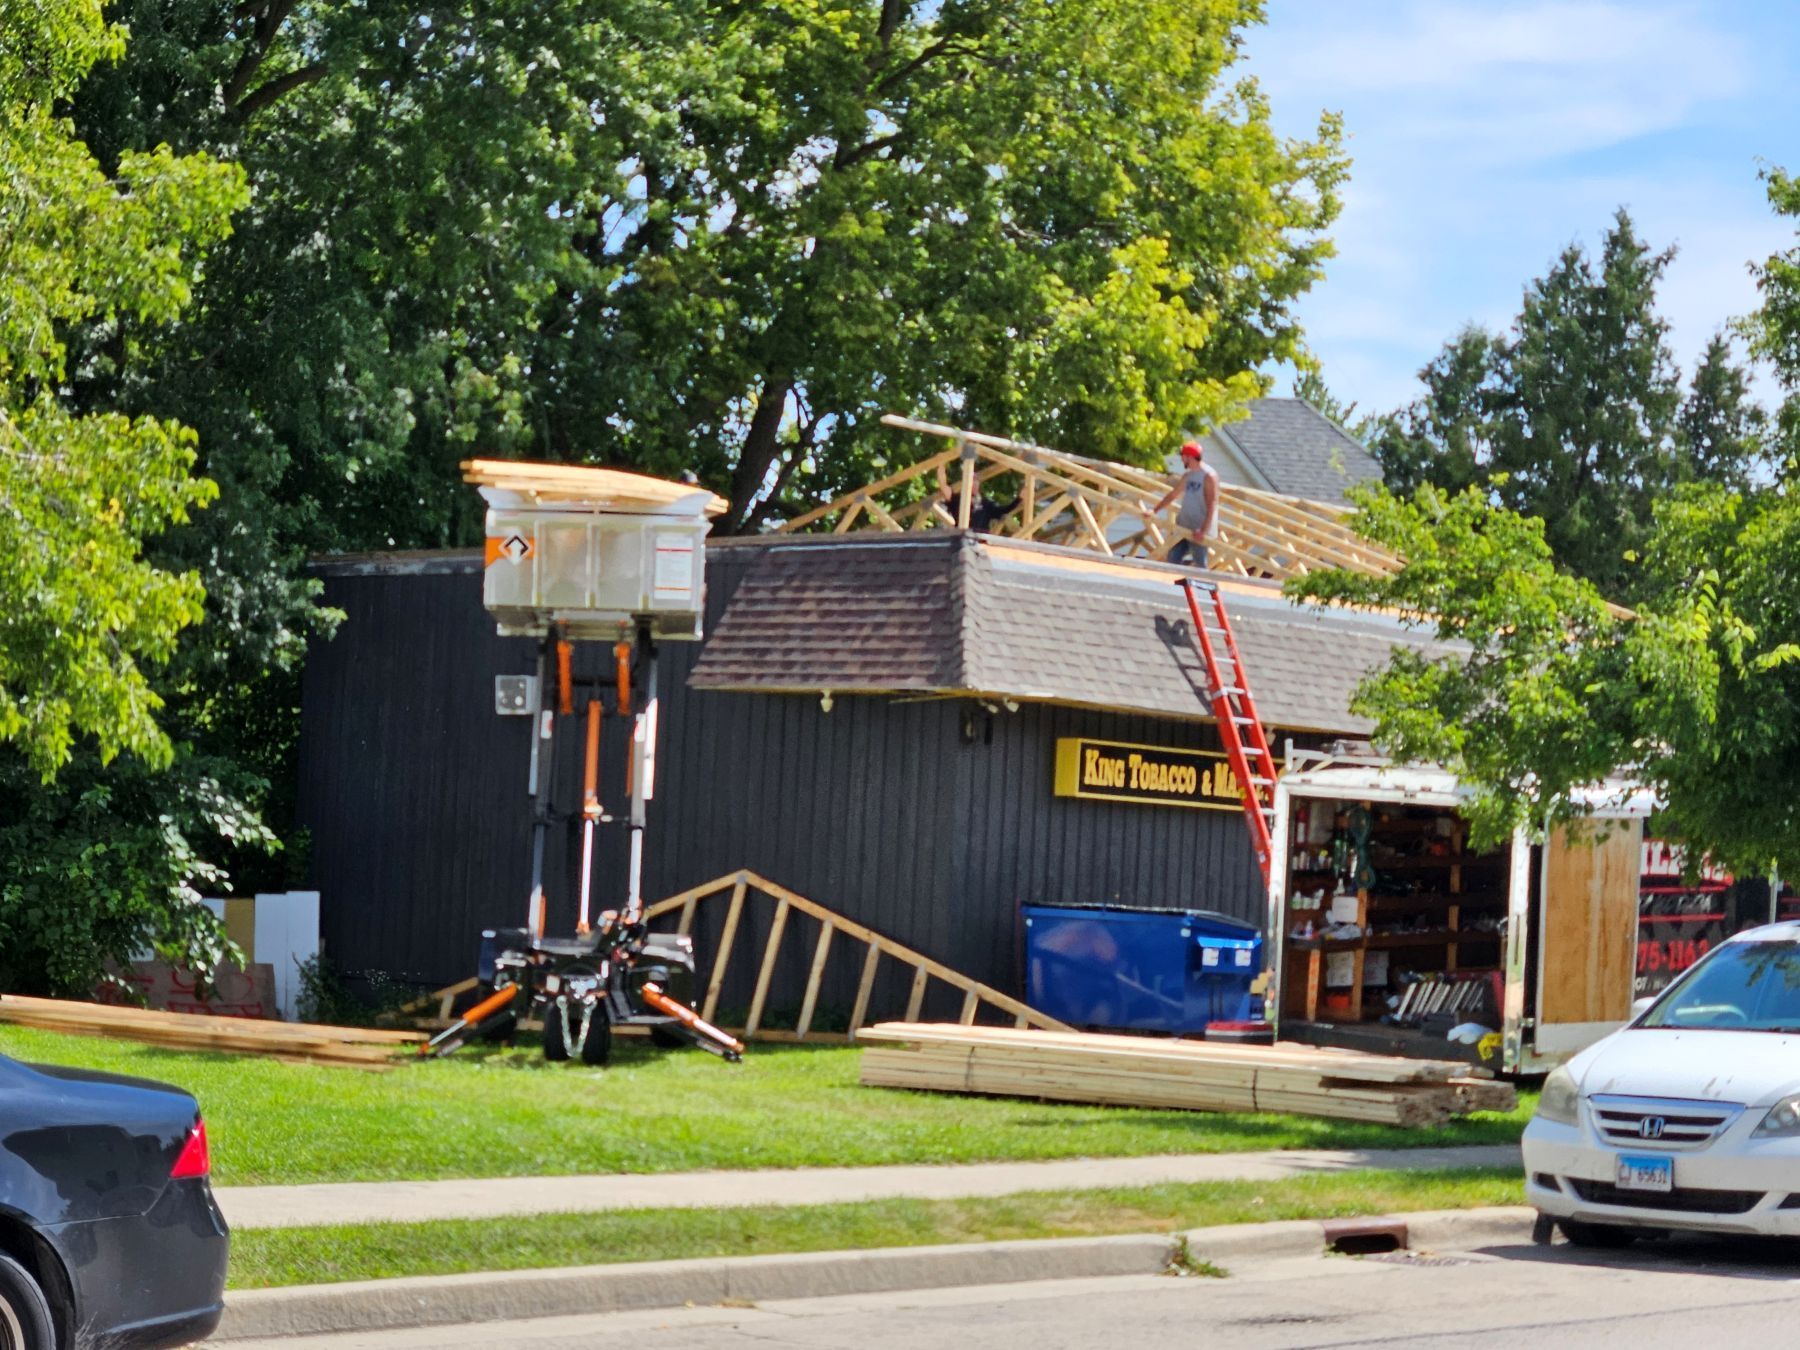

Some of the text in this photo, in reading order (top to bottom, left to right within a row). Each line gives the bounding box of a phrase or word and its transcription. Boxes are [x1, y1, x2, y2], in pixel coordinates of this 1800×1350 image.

[1084, 749, 1126, 788] KING
[1128, 753, 1197, 795] TOBACCO
[1201, 769, 1213, 796] &
